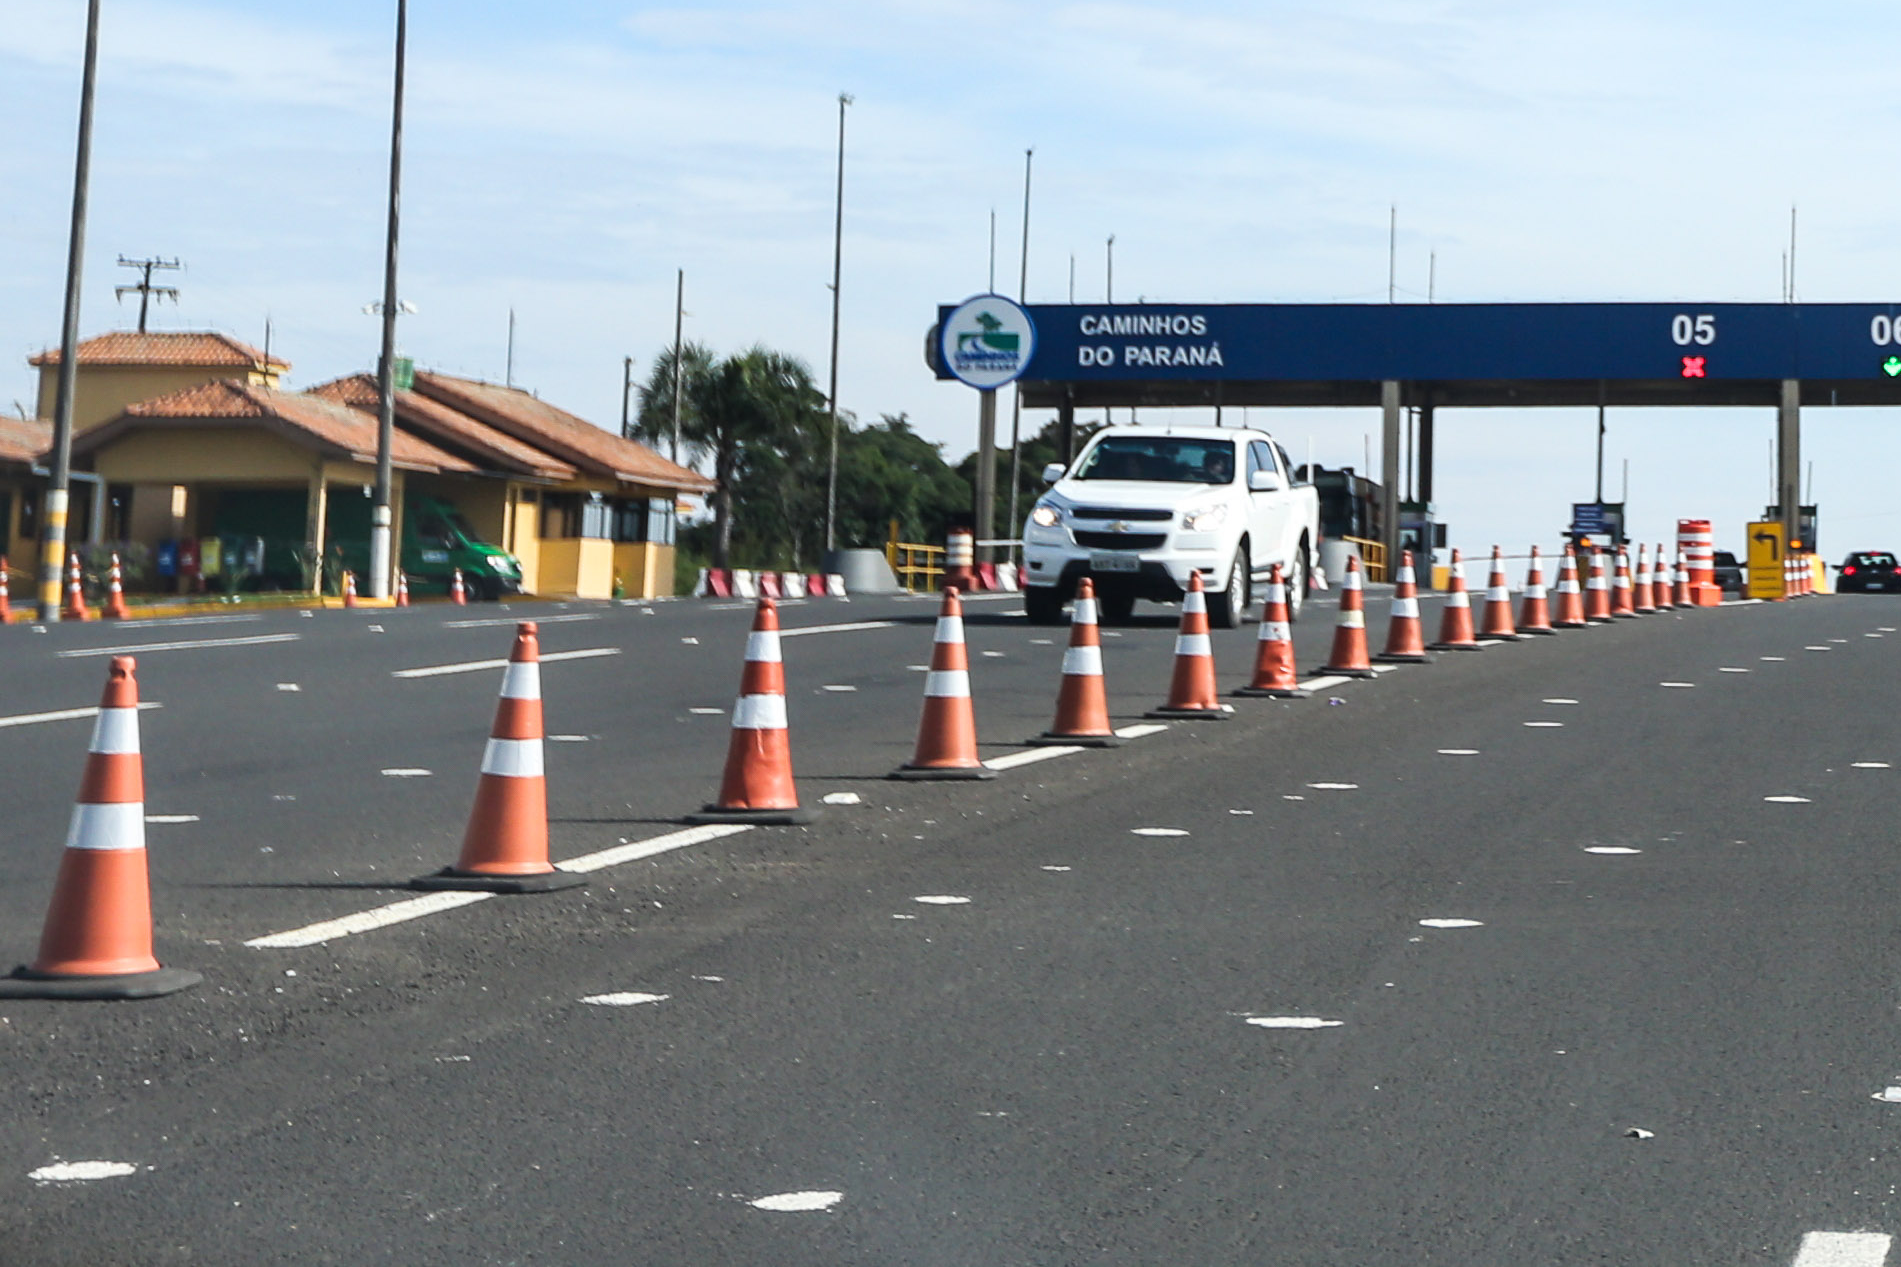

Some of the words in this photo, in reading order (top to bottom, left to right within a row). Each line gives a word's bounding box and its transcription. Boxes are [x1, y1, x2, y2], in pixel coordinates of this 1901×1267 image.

[1079, 314, 1207, 335] CAMINHOS
[1671, 315, 1716, 346] 05
[1078, 345, 1114, 366] DO
[1124, 341, 1224, 366] PARANÁ
